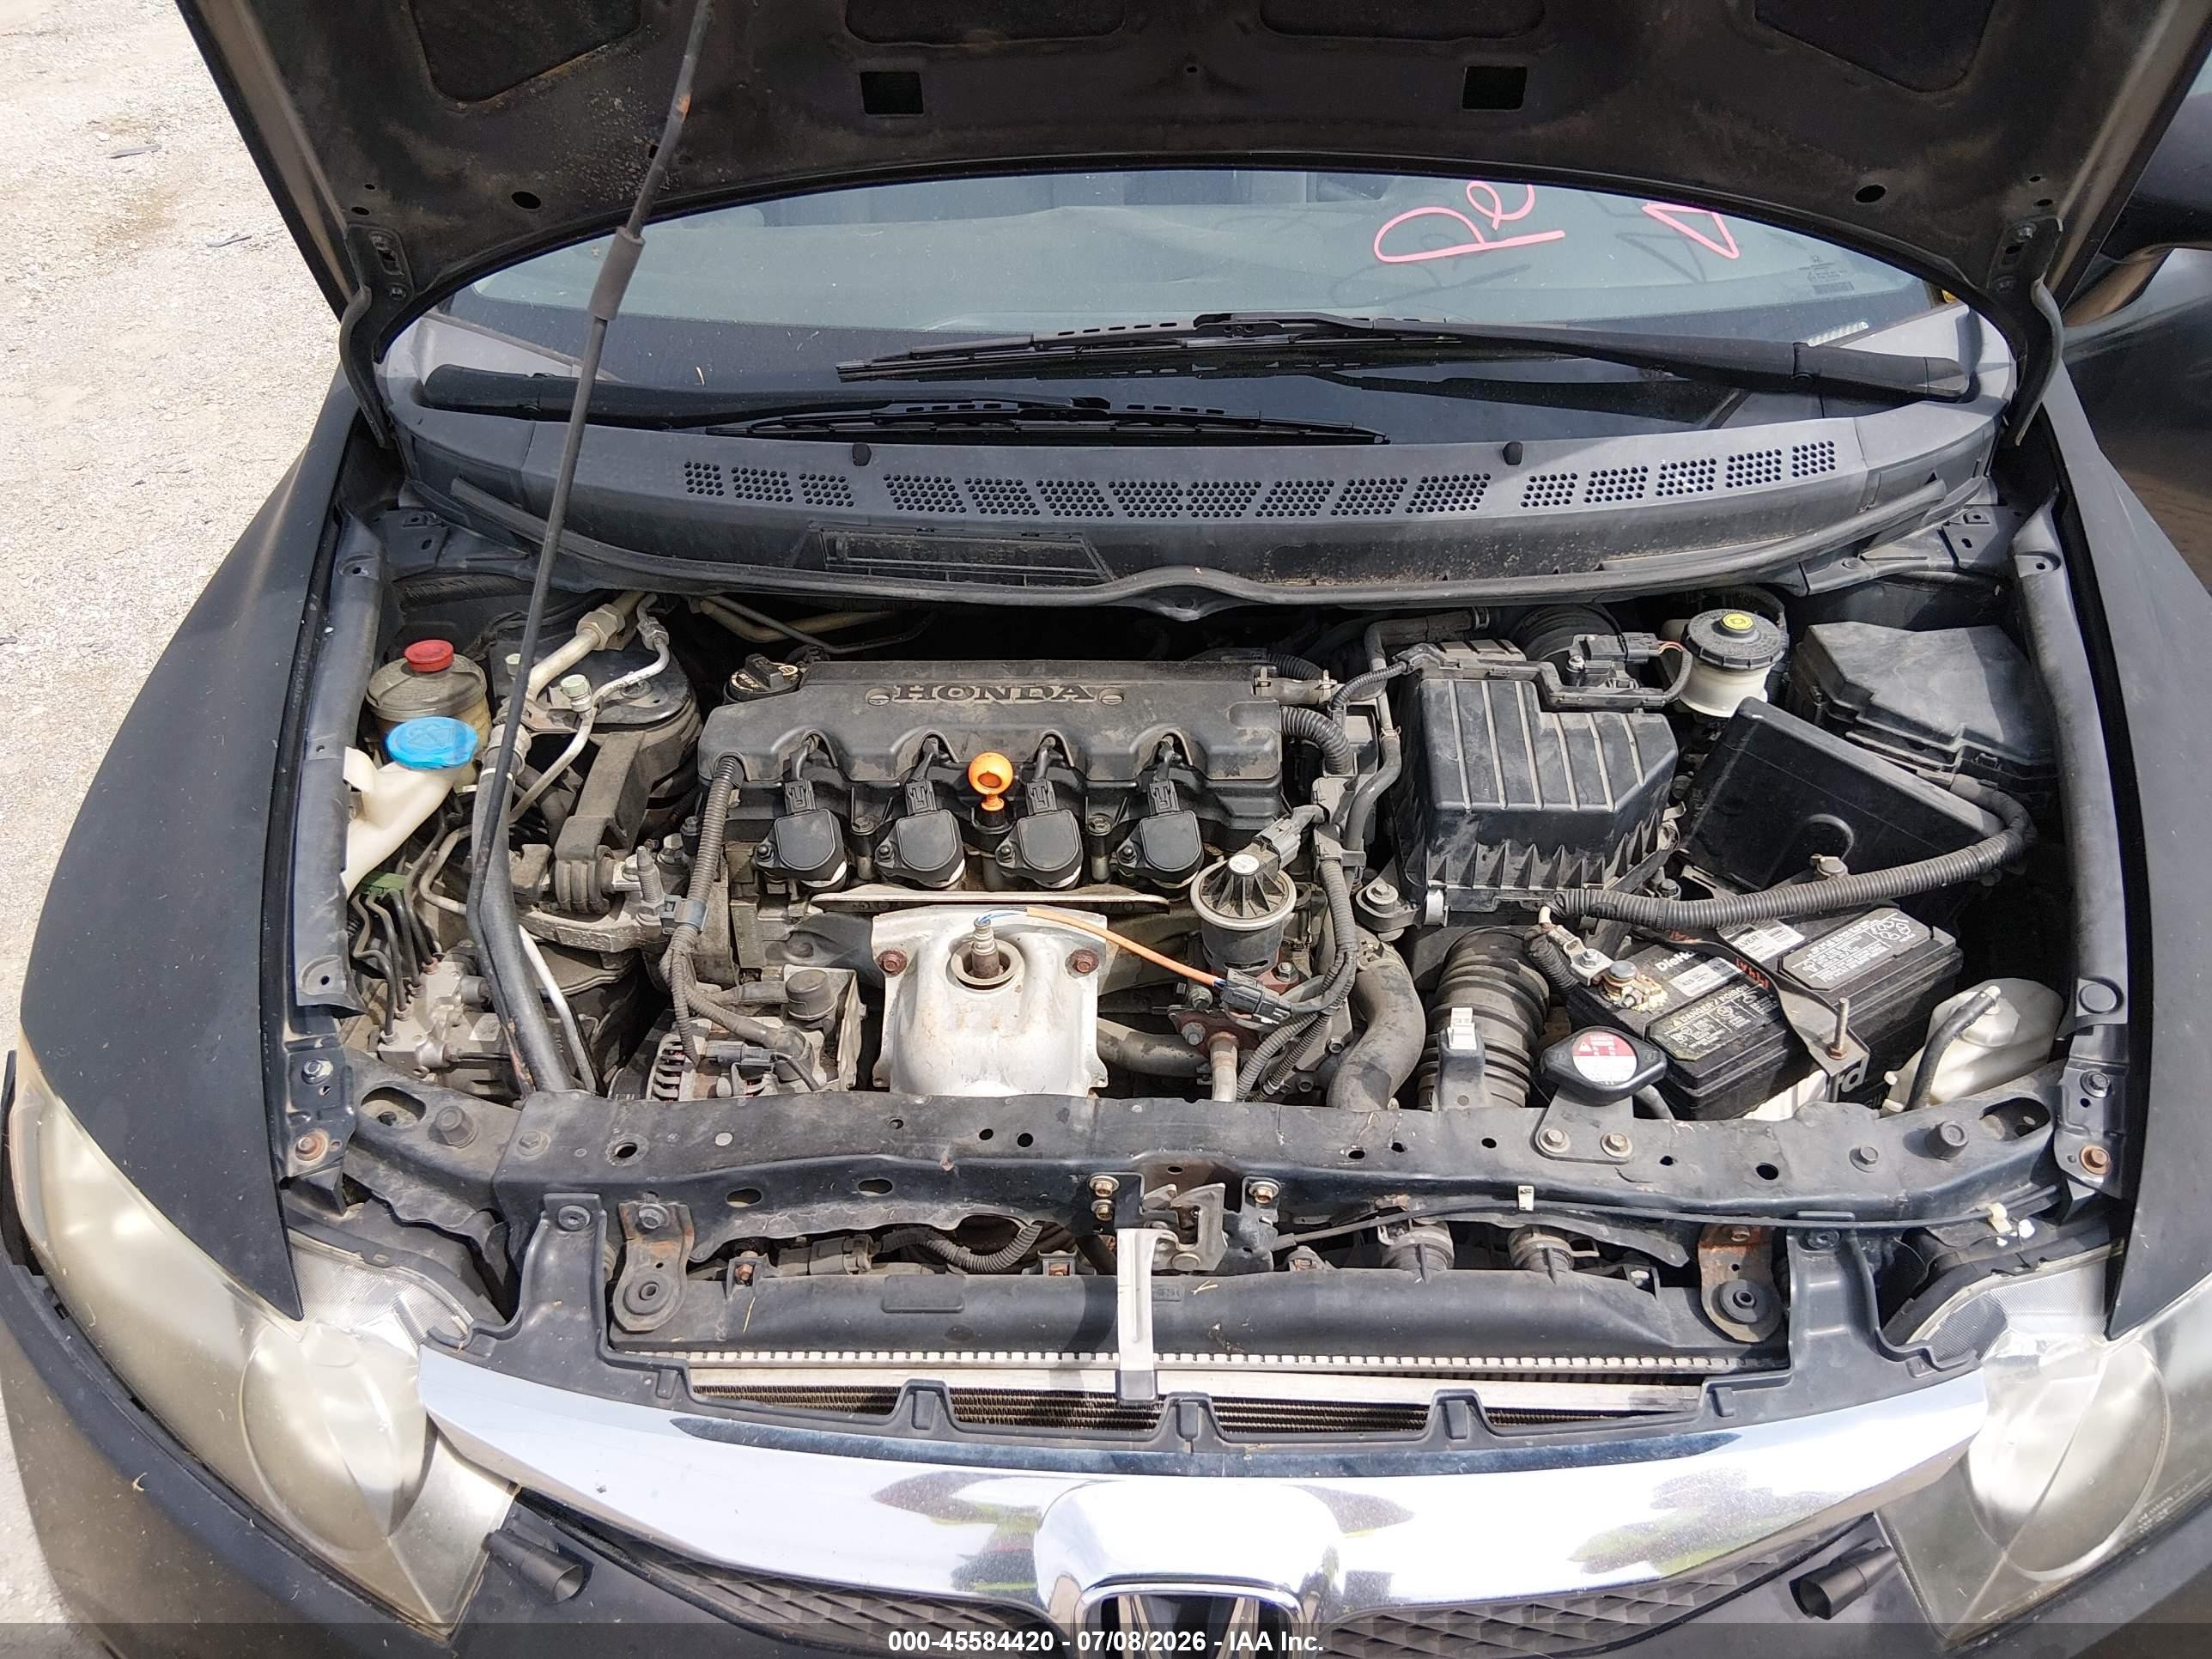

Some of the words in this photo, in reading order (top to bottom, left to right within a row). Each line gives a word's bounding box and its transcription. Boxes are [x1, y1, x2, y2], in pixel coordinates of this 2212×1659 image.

[893, 684, 1096, 702] HONDA
[1680, 1000, 1716, 1023] DANGER
[1719, 984, 1753, 1004] POISON
